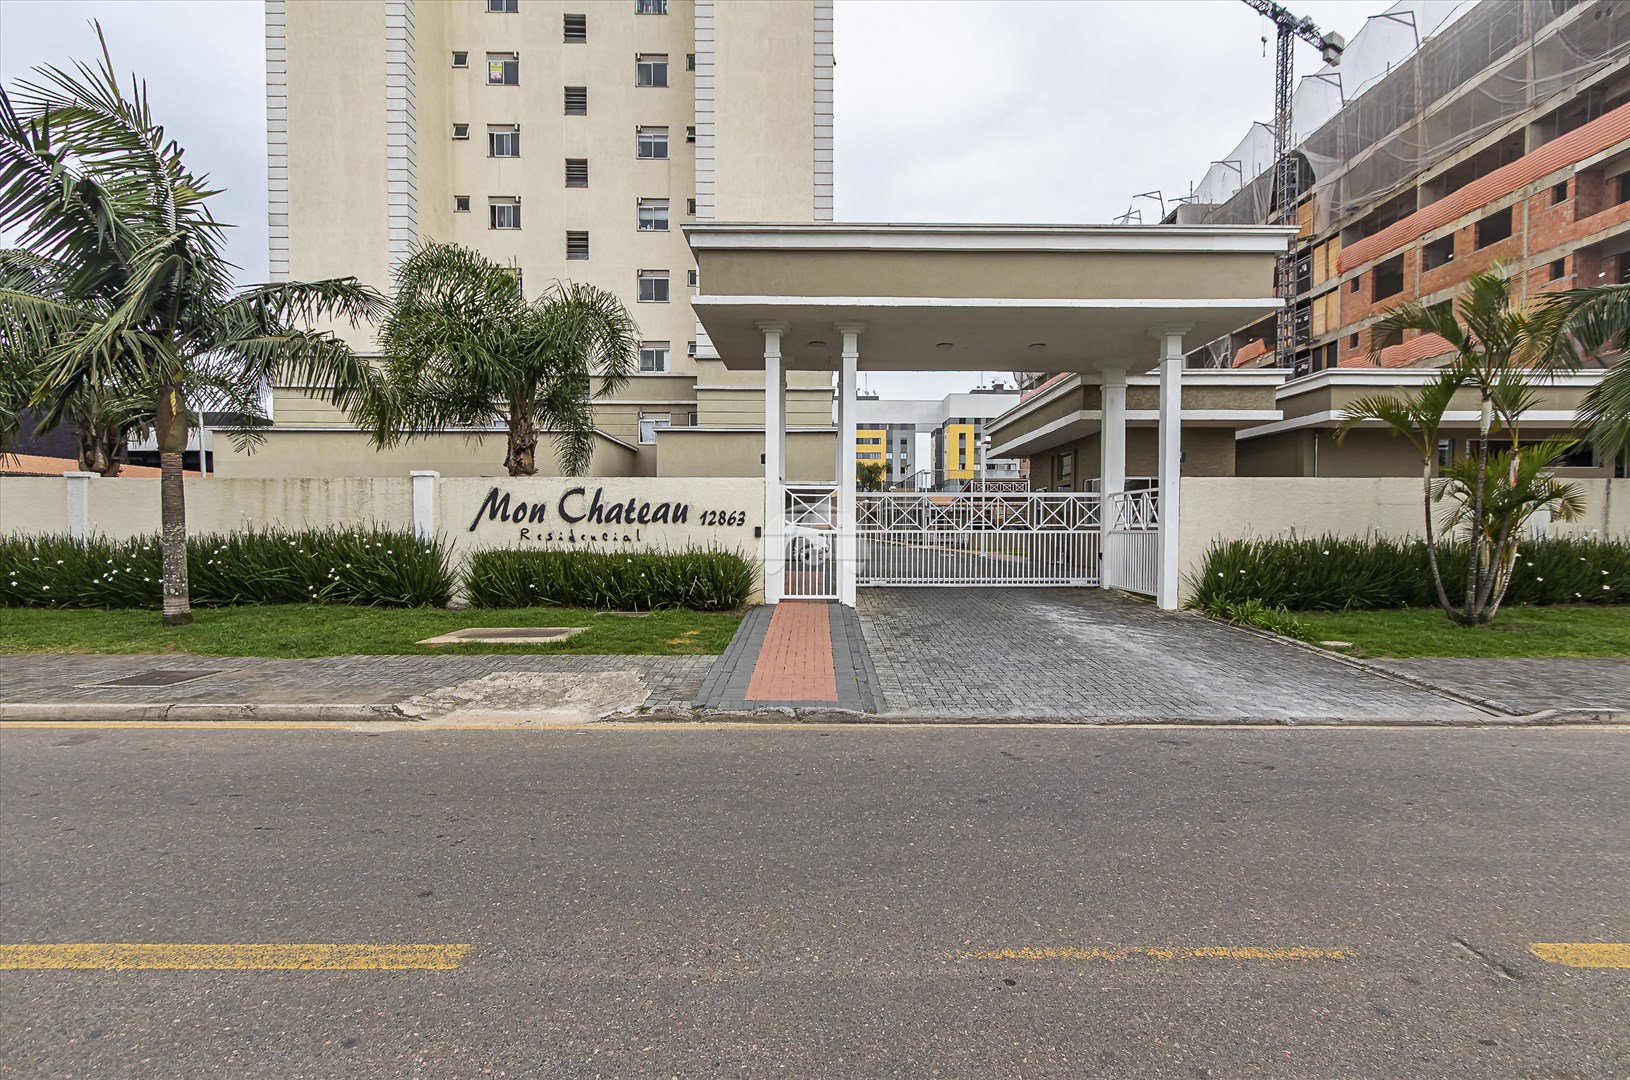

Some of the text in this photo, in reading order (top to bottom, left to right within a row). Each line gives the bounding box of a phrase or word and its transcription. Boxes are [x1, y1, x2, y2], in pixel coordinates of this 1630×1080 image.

[469, 486, 746, 531] Mon Chateau 12863
[520, 527, 641, 543] Residencial
